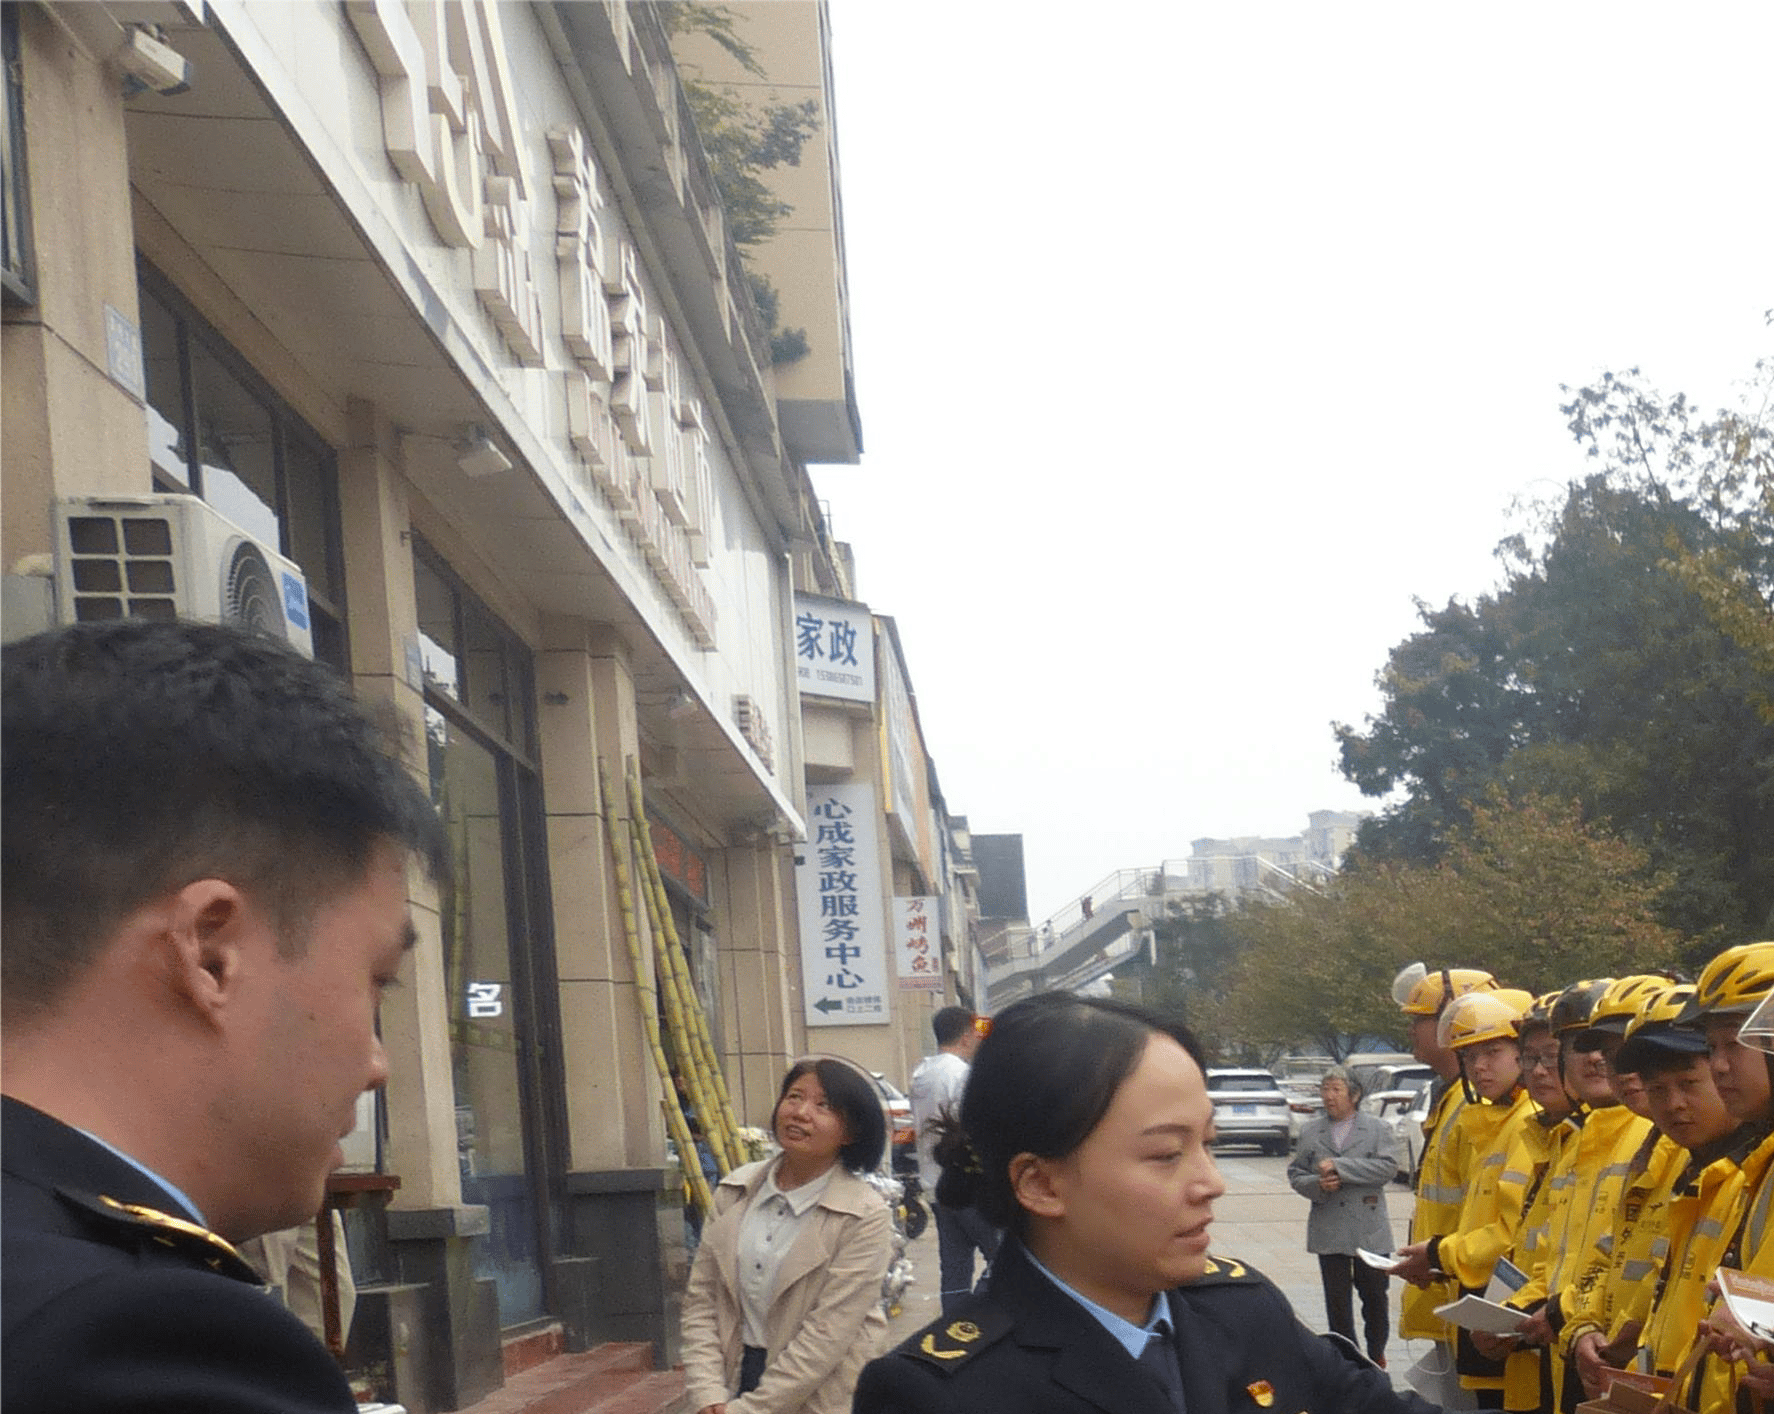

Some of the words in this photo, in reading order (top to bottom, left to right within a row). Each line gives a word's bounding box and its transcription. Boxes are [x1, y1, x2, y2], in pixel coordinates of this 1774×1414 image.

[797, 611, 858, 666] 家政
[814, 798, 865, 989] 心成家政服务中心
